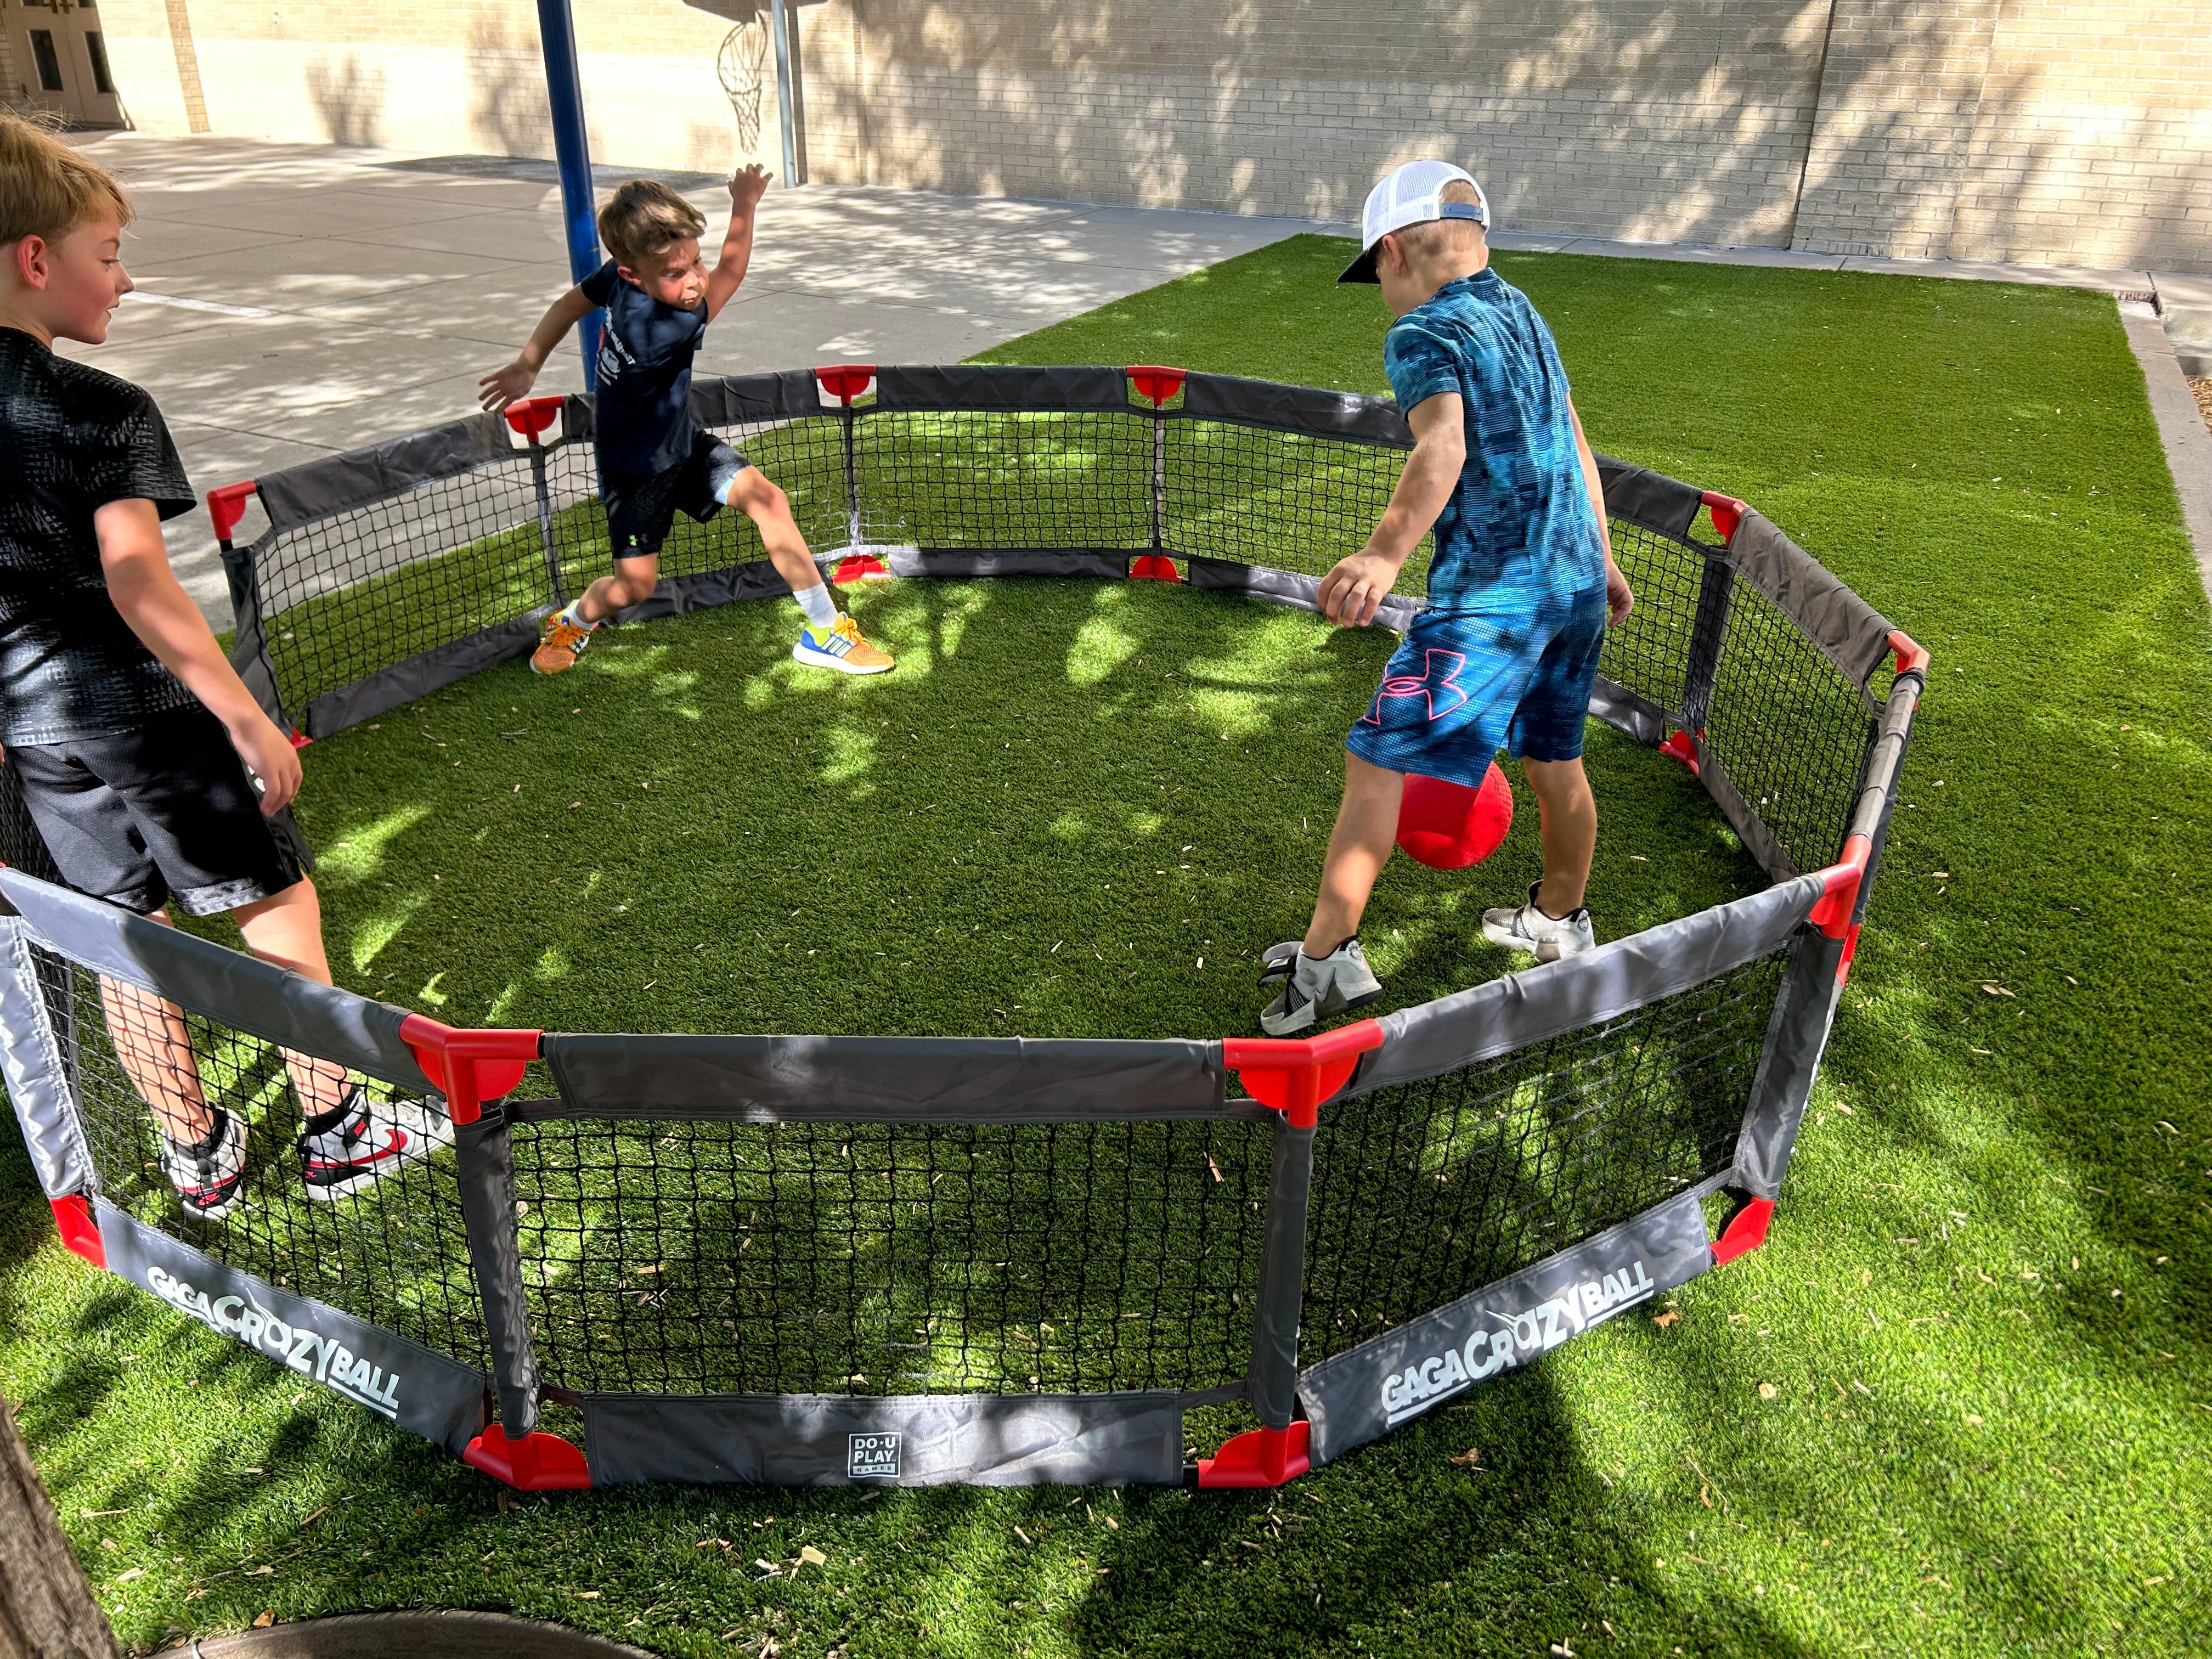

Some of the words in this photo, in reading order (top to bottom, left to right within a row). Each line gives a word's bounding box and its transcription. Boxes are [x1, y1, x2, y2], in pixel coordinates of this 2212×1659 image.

[855, 1437, 878, 1449] DO
[885, 1436, 896, 1448] U
[854, 1450, 895, 1463] PLAY
